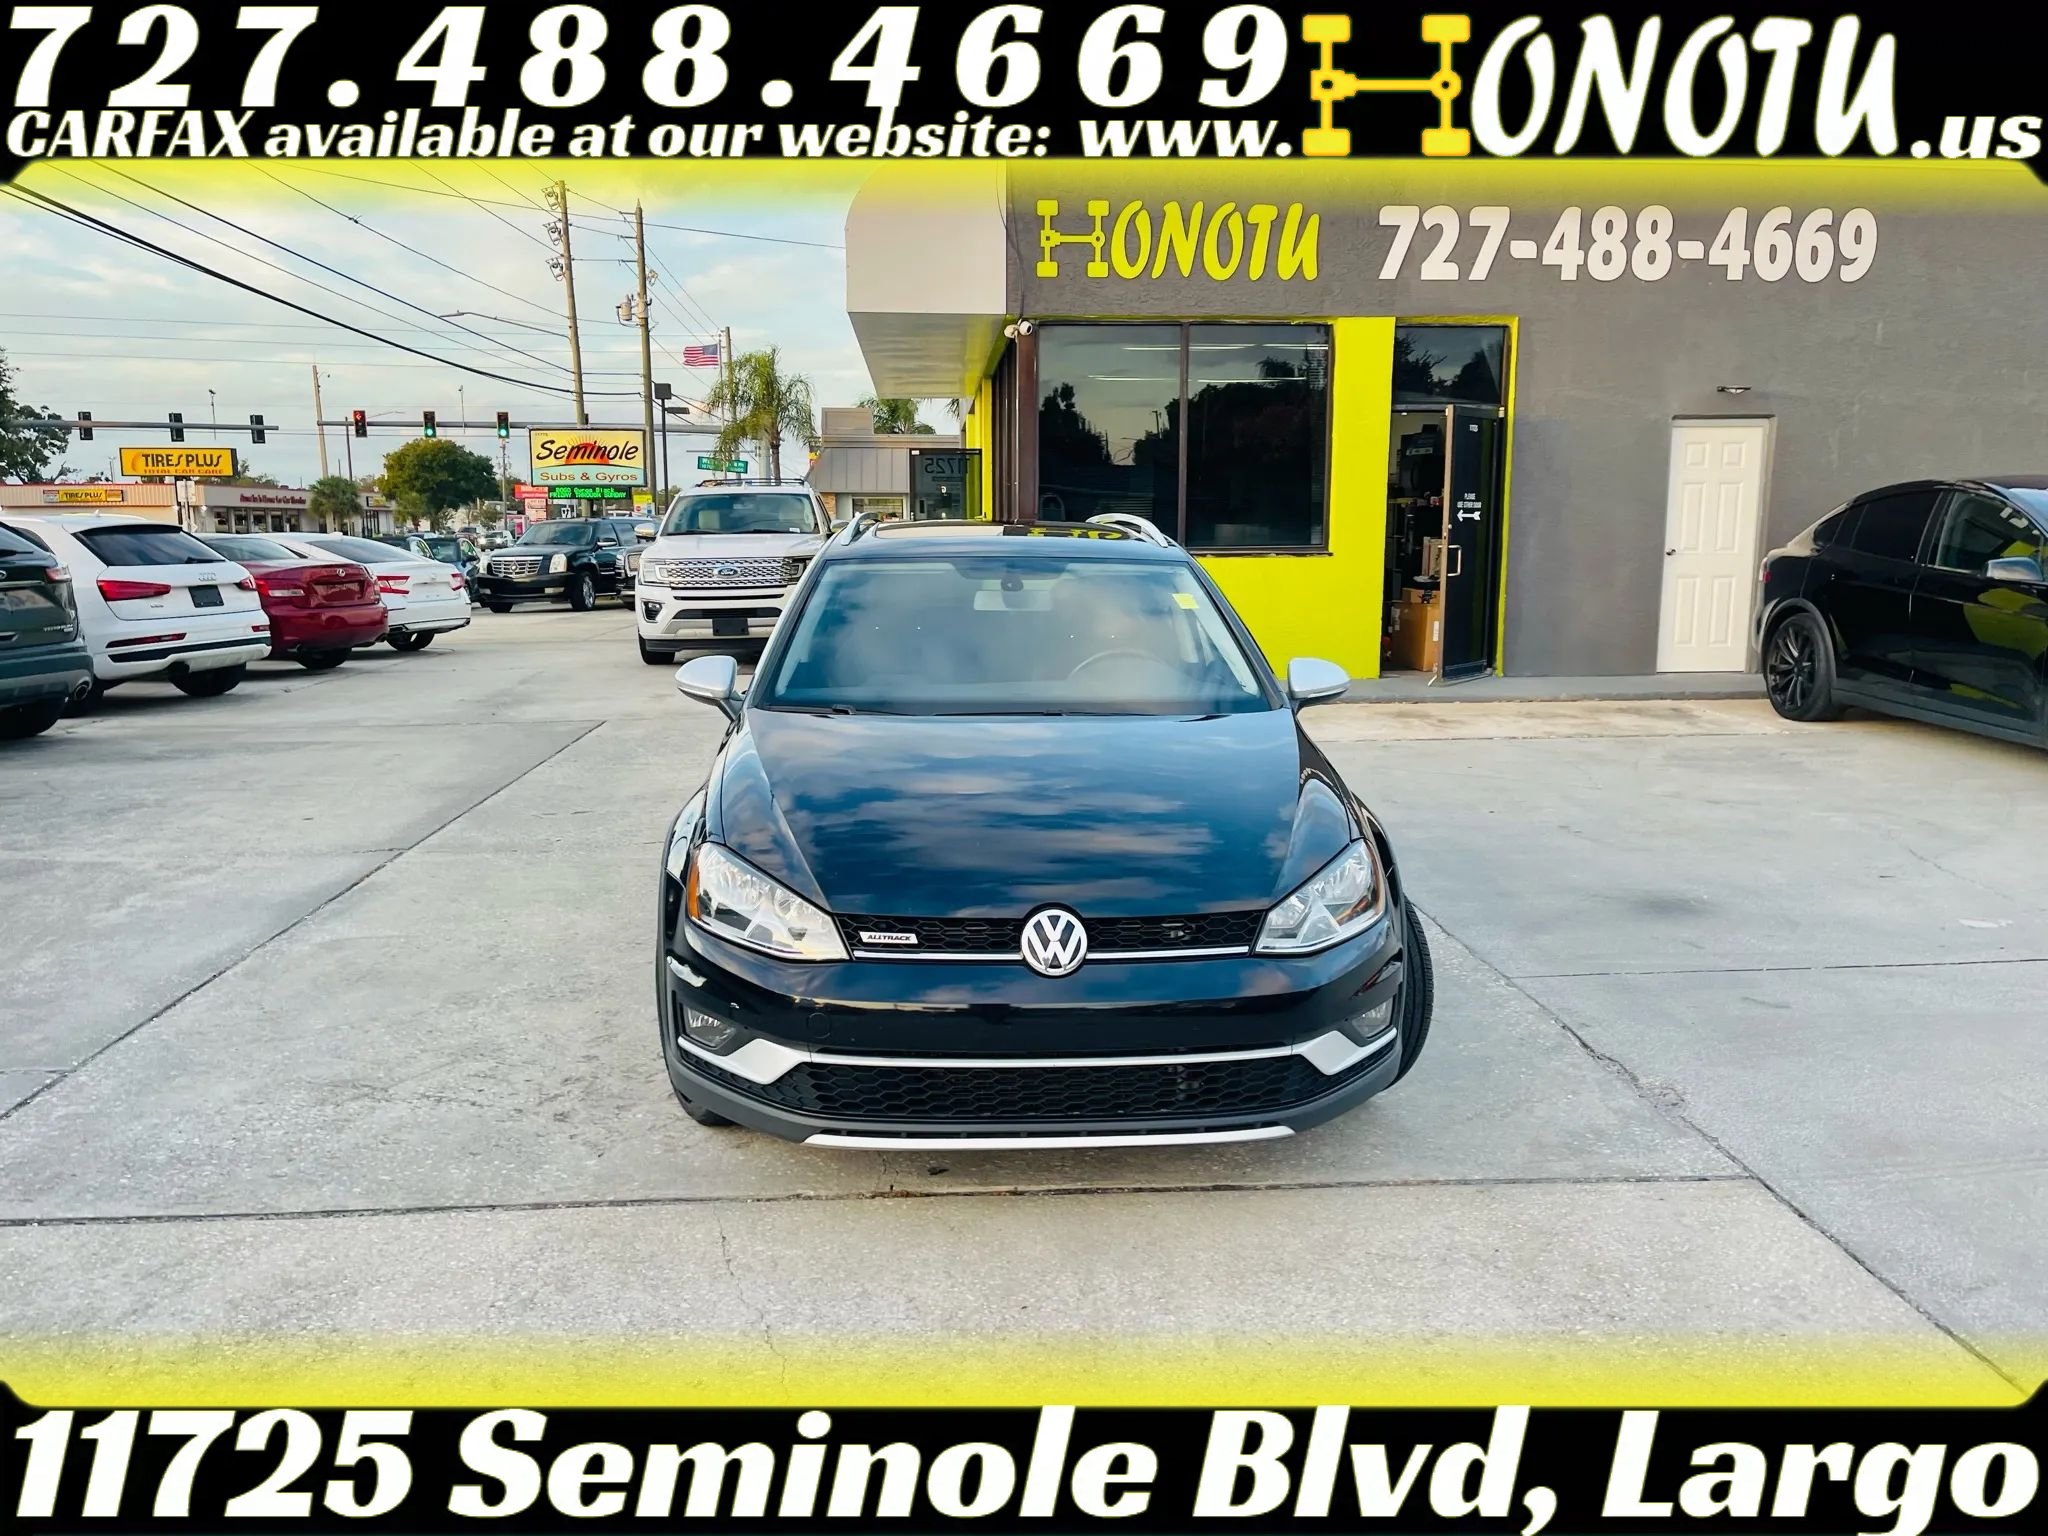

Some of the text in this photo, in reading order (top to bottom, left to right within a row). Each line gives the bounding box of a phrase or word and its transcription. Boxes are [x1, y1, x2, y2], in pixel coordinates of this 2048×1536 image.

[1036, 199, 1321, 282] HONOTU
[1378, 204, 1878, 283] 727-488-4669
[536, 439, 639, 461] Seminole
[142, 453, 222, 467] TIRES PLUS
[540, 472, 638, 483] Subs & Gyros
[866, 934, 912, 942] ALLTRACK
